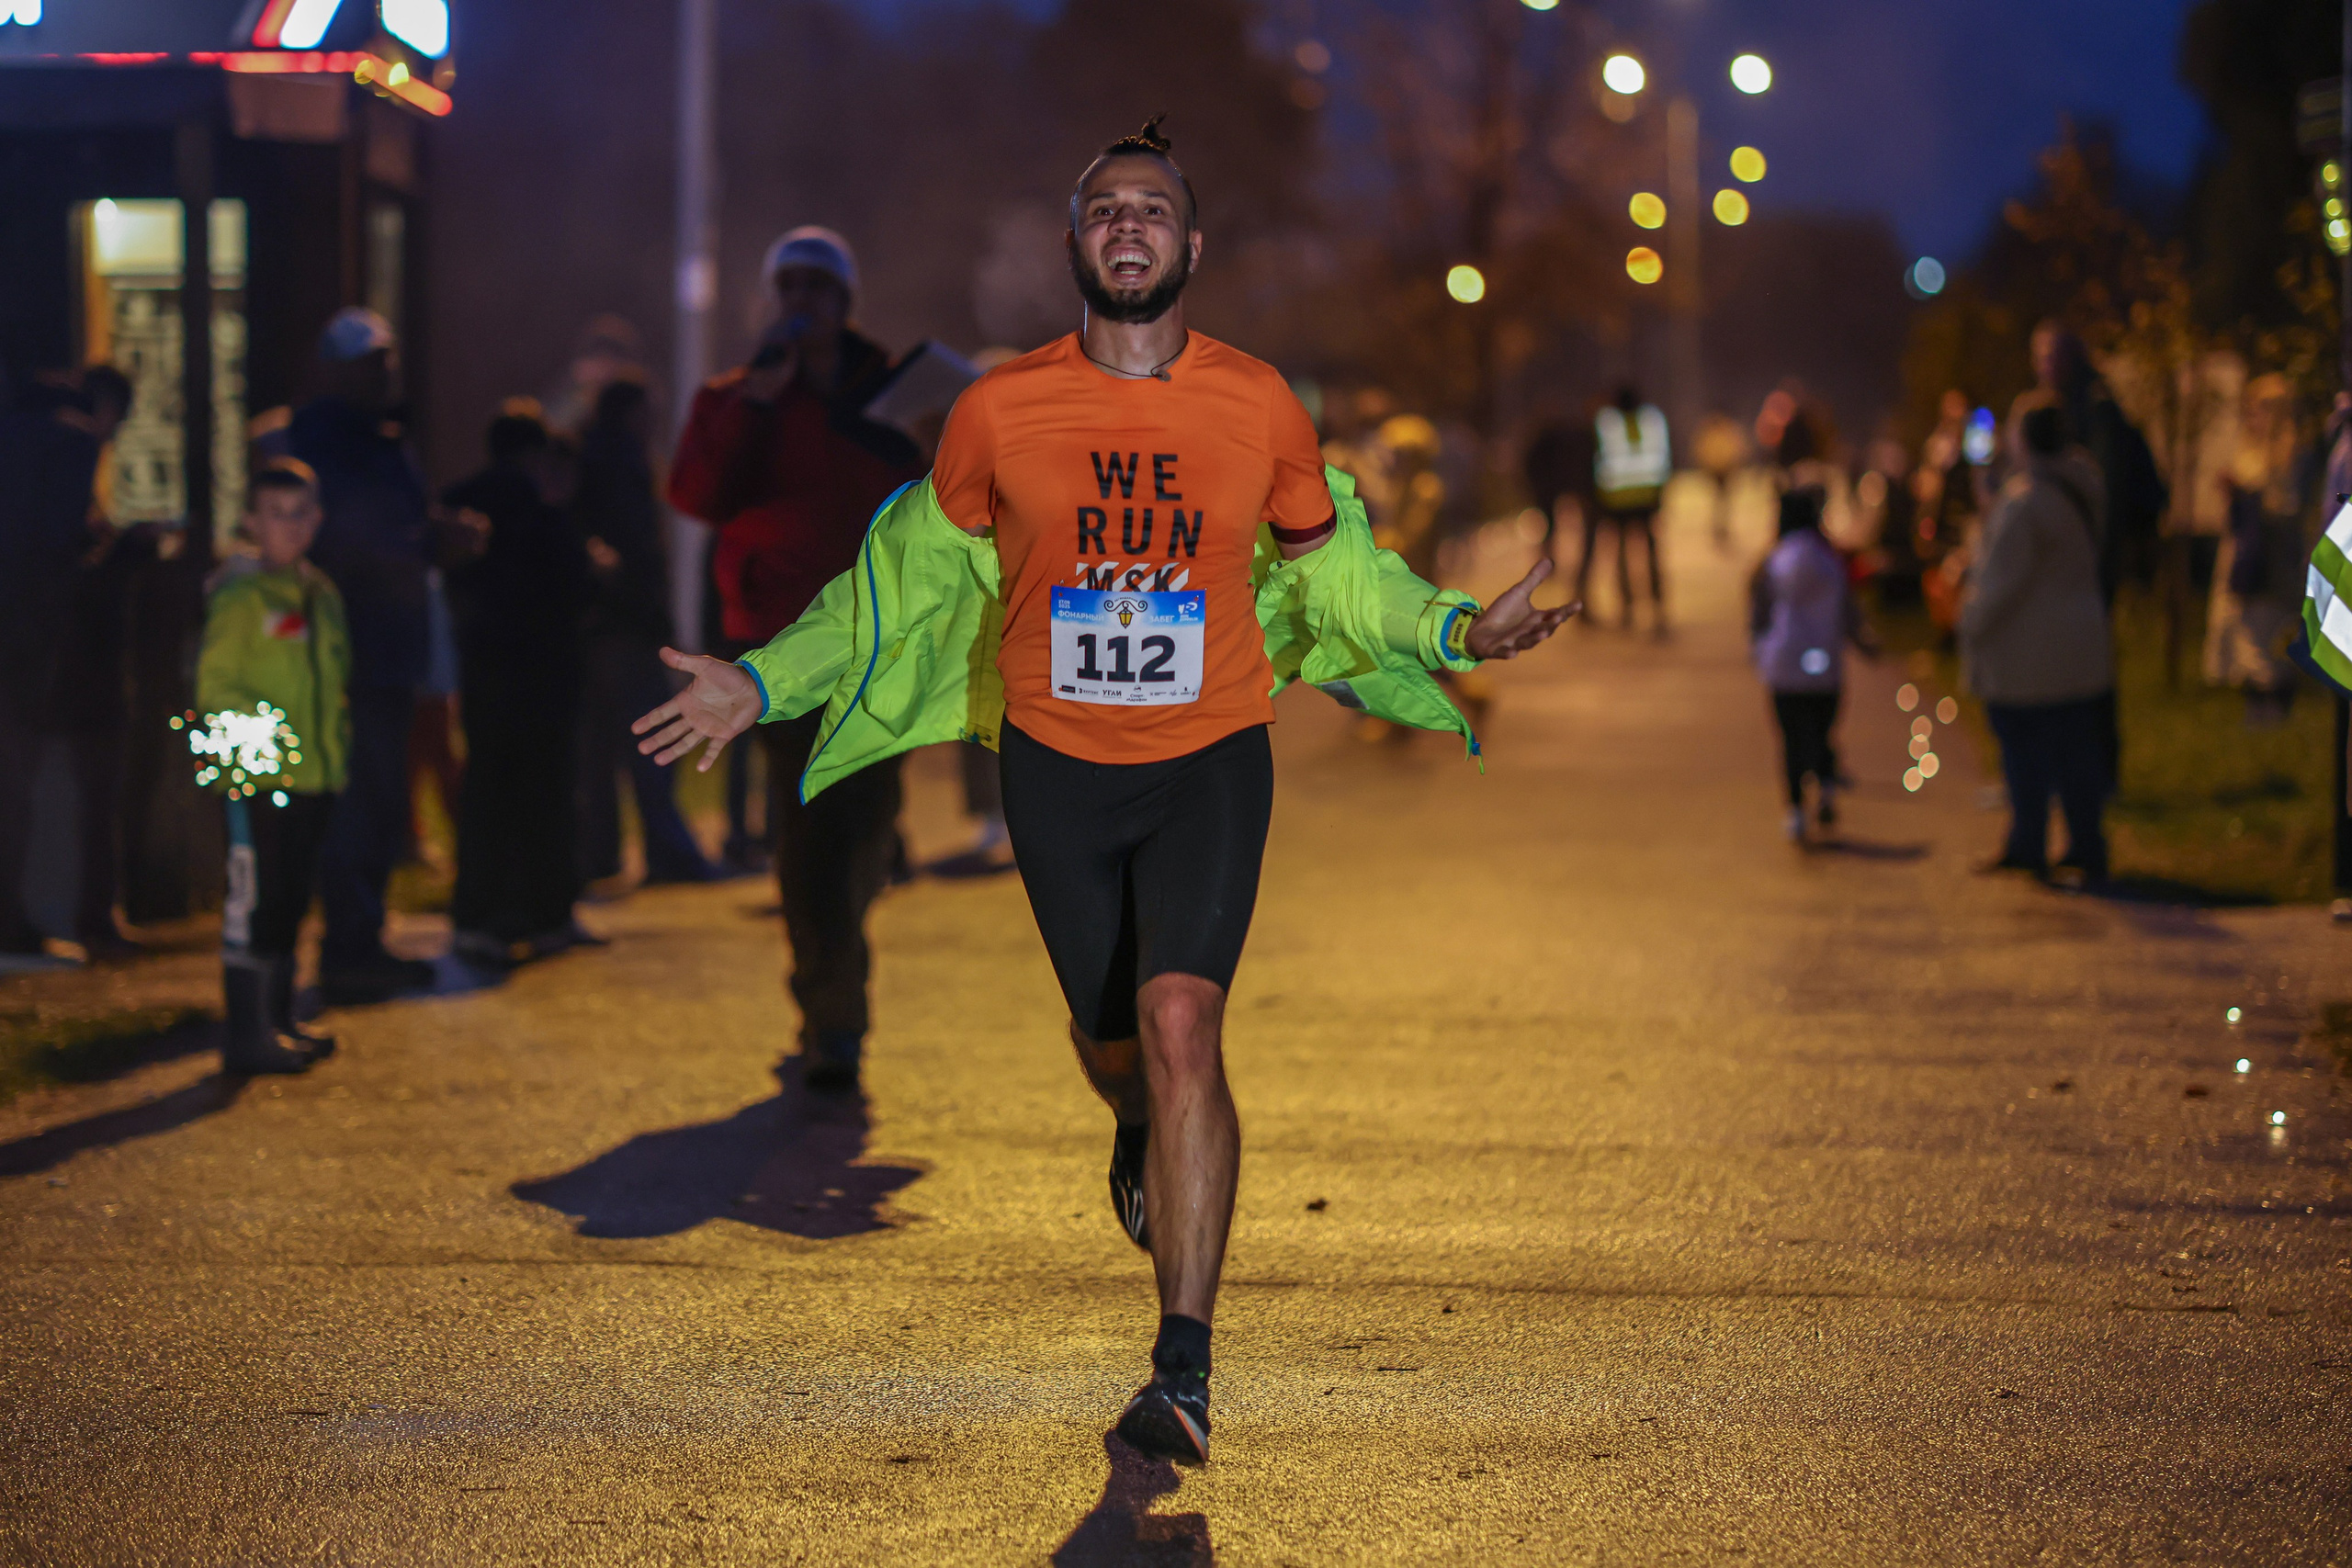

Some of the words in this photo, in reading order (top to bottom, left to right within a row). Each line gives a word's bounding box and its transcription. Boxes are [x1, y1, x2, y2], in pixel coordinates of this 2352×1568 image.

[1091, 451, 1182, 502] WE
[1077, 507, 1203, 558] RUN
[1077, 634, 1176, 682] 112
